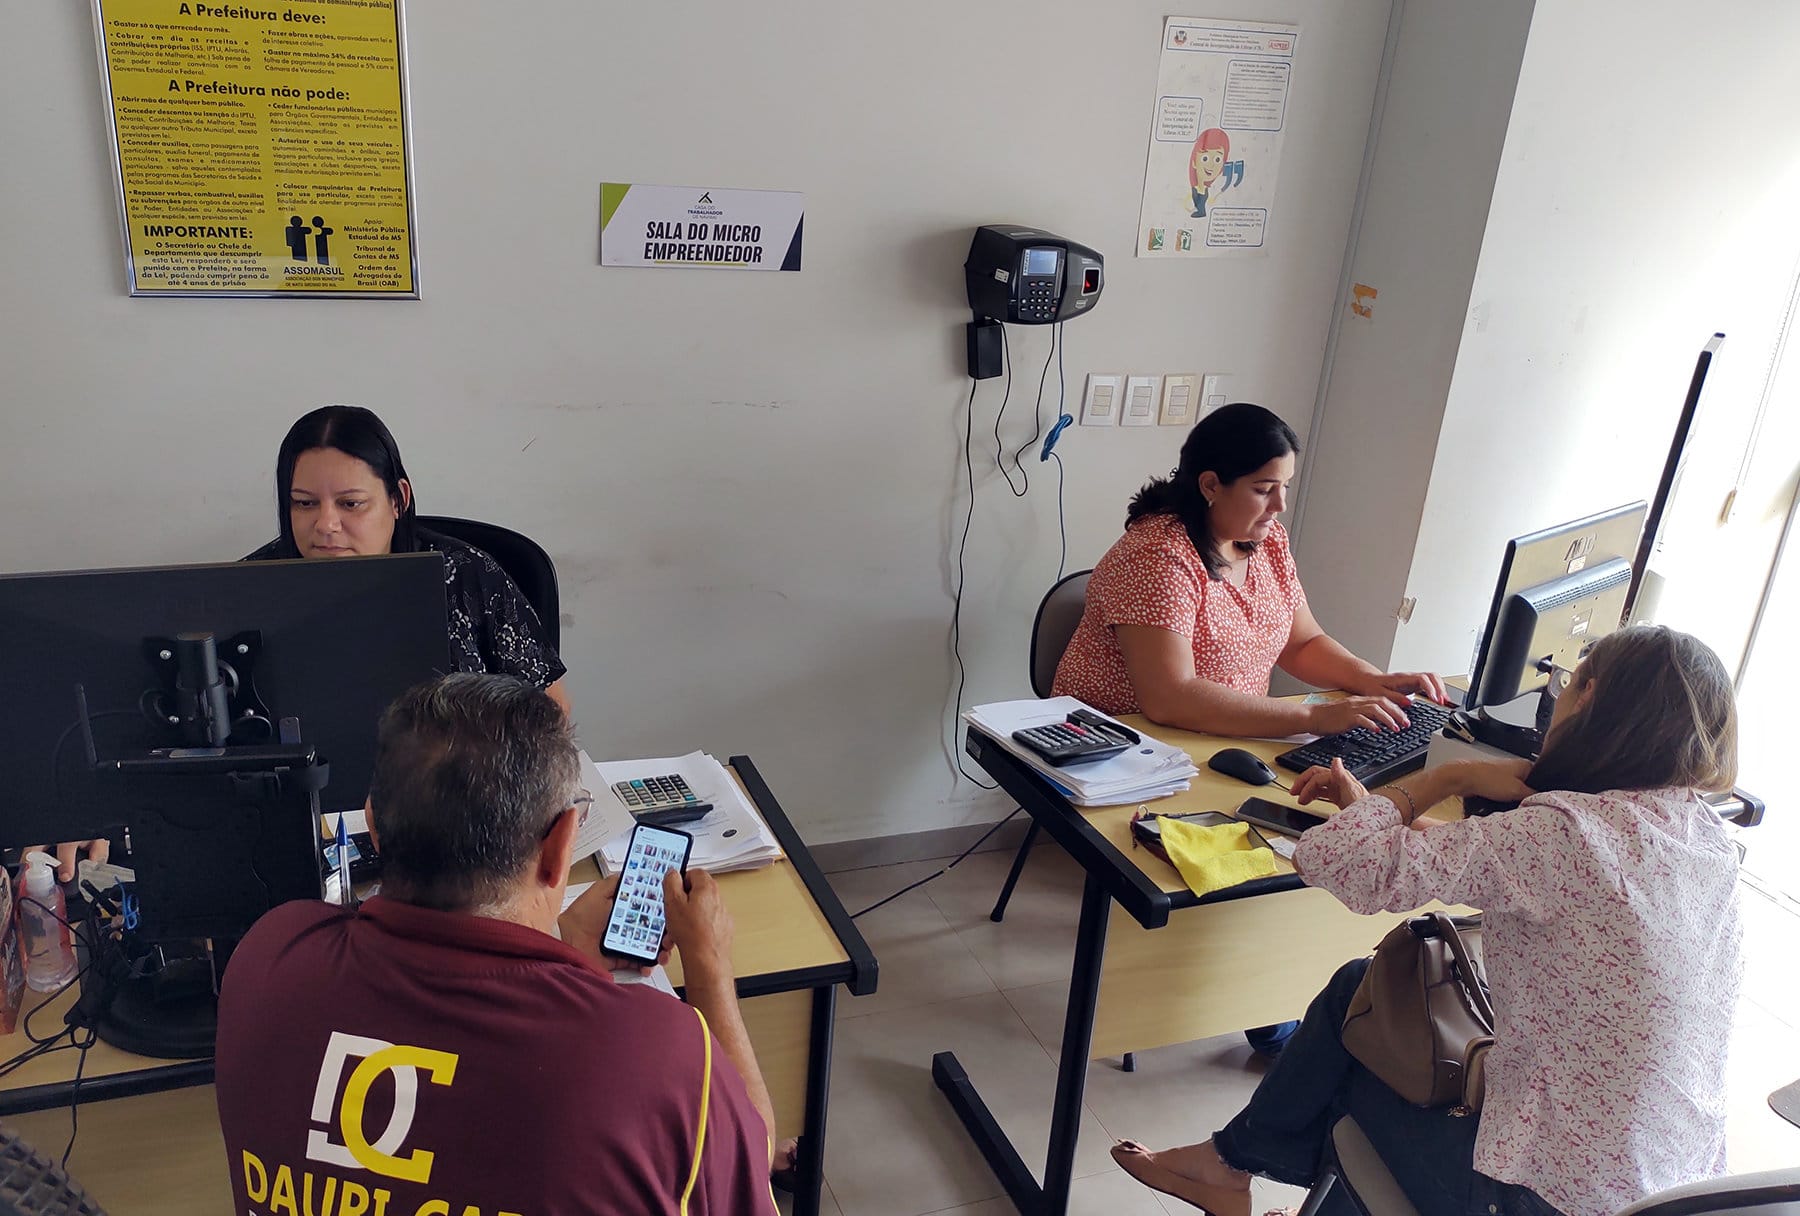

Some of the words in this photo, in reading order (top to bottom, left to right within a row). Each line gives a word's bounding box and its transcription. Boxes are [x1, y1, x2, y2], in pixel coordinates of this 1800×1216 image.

[177, 3, 190, 15] A
[195, 4, 276, 20] Prefeitura
[282, 9, 326, 23] deve:
[205, 36, 237, 44] receitas
[166, 79, 180, 91] A
[184, 80, 266, 95] Prefeitura
[270, 84, 300, 96] não
[306, 86, 350, 102] pode:
[143, 225, 253, 238] IMPORTANTE:
[646, 221, 682, 240] SALA
[687, 222, 708, 241] DO
[712, 223, 761, 243] MICRO
[643, 242, 763, 263] EMPREENDEDOR
[282, 266, 344, 274] ASSOMASUL
[242, 1149, 391, 1216] DAURI
